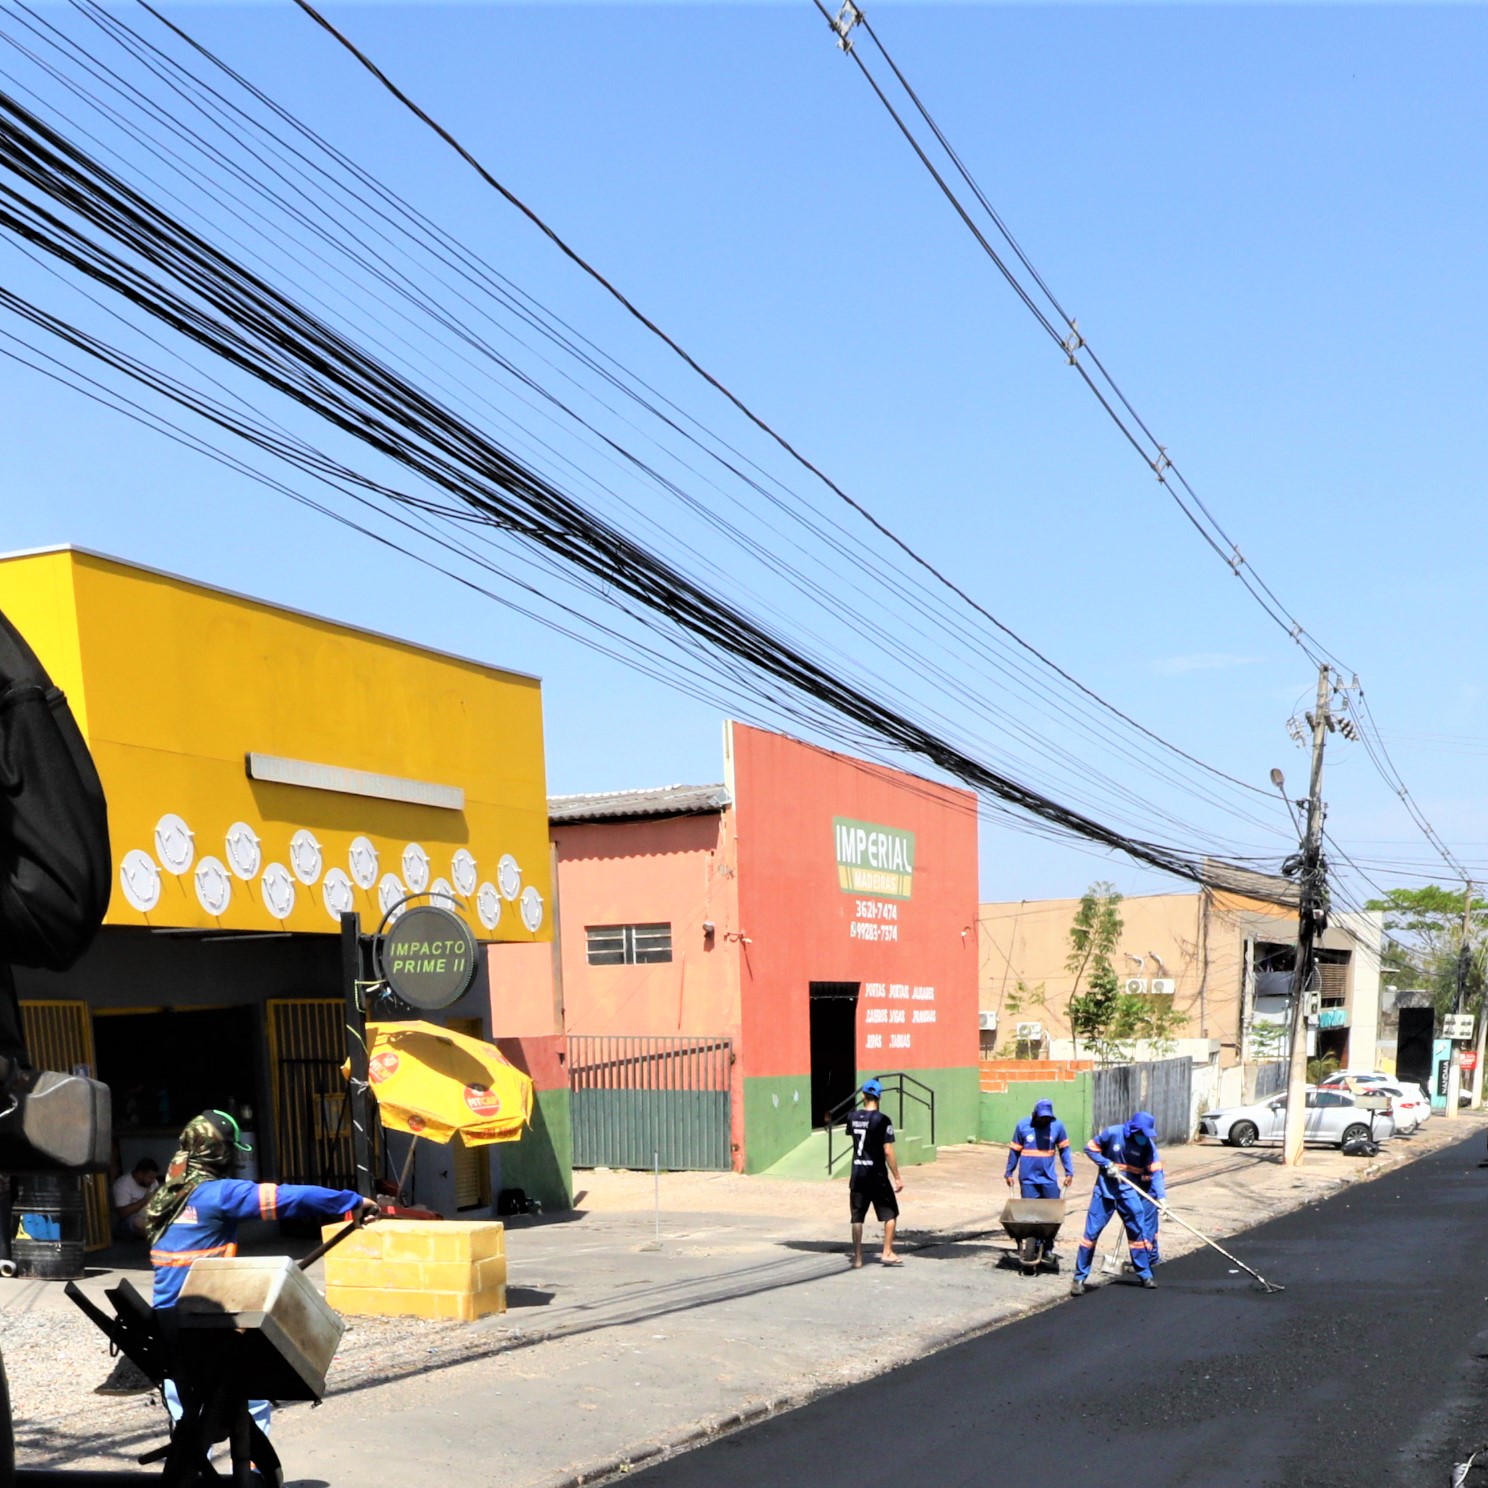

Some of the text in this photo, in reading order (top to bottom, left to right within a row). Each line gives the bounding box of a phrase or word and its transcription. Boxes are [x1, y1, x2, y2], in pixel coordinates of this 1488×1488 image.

[836, 824, 913, 873] IMPERIAL
[854, 871, 897, 891] MADEIRAS
[390, 940, 466, 957] IMPACTO
[393, 958, 465, 974] PRIME II
[853, 1129, 867, 1157] 7
